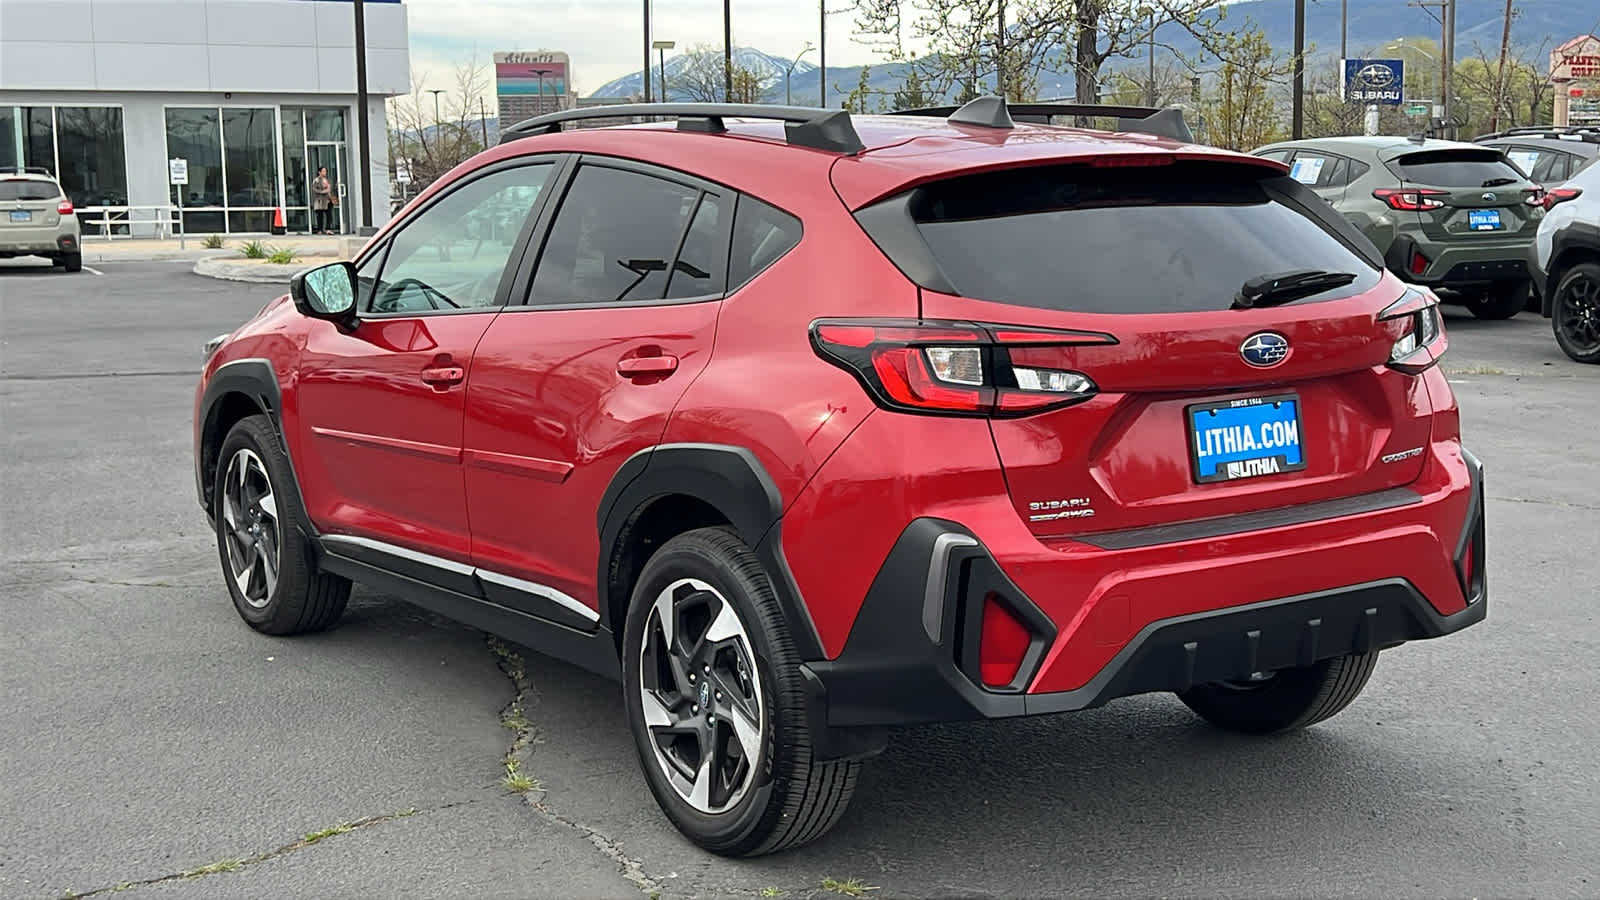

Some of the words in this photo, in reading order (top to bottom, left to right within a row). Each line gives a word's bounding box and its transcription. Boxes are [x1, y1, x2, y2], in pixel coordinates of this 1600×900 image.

[1351, 91, 1400, 100] SUBARU
[1231, 400, 1249, 408] SINCE
[1196, 419, 1299, 457] LITHIA.COM
[1239, 457, 1280, 478] LITHIA
[1029, 497, 1090, 510] SUBARU
[1056, 509, 1095, 520] AWD
